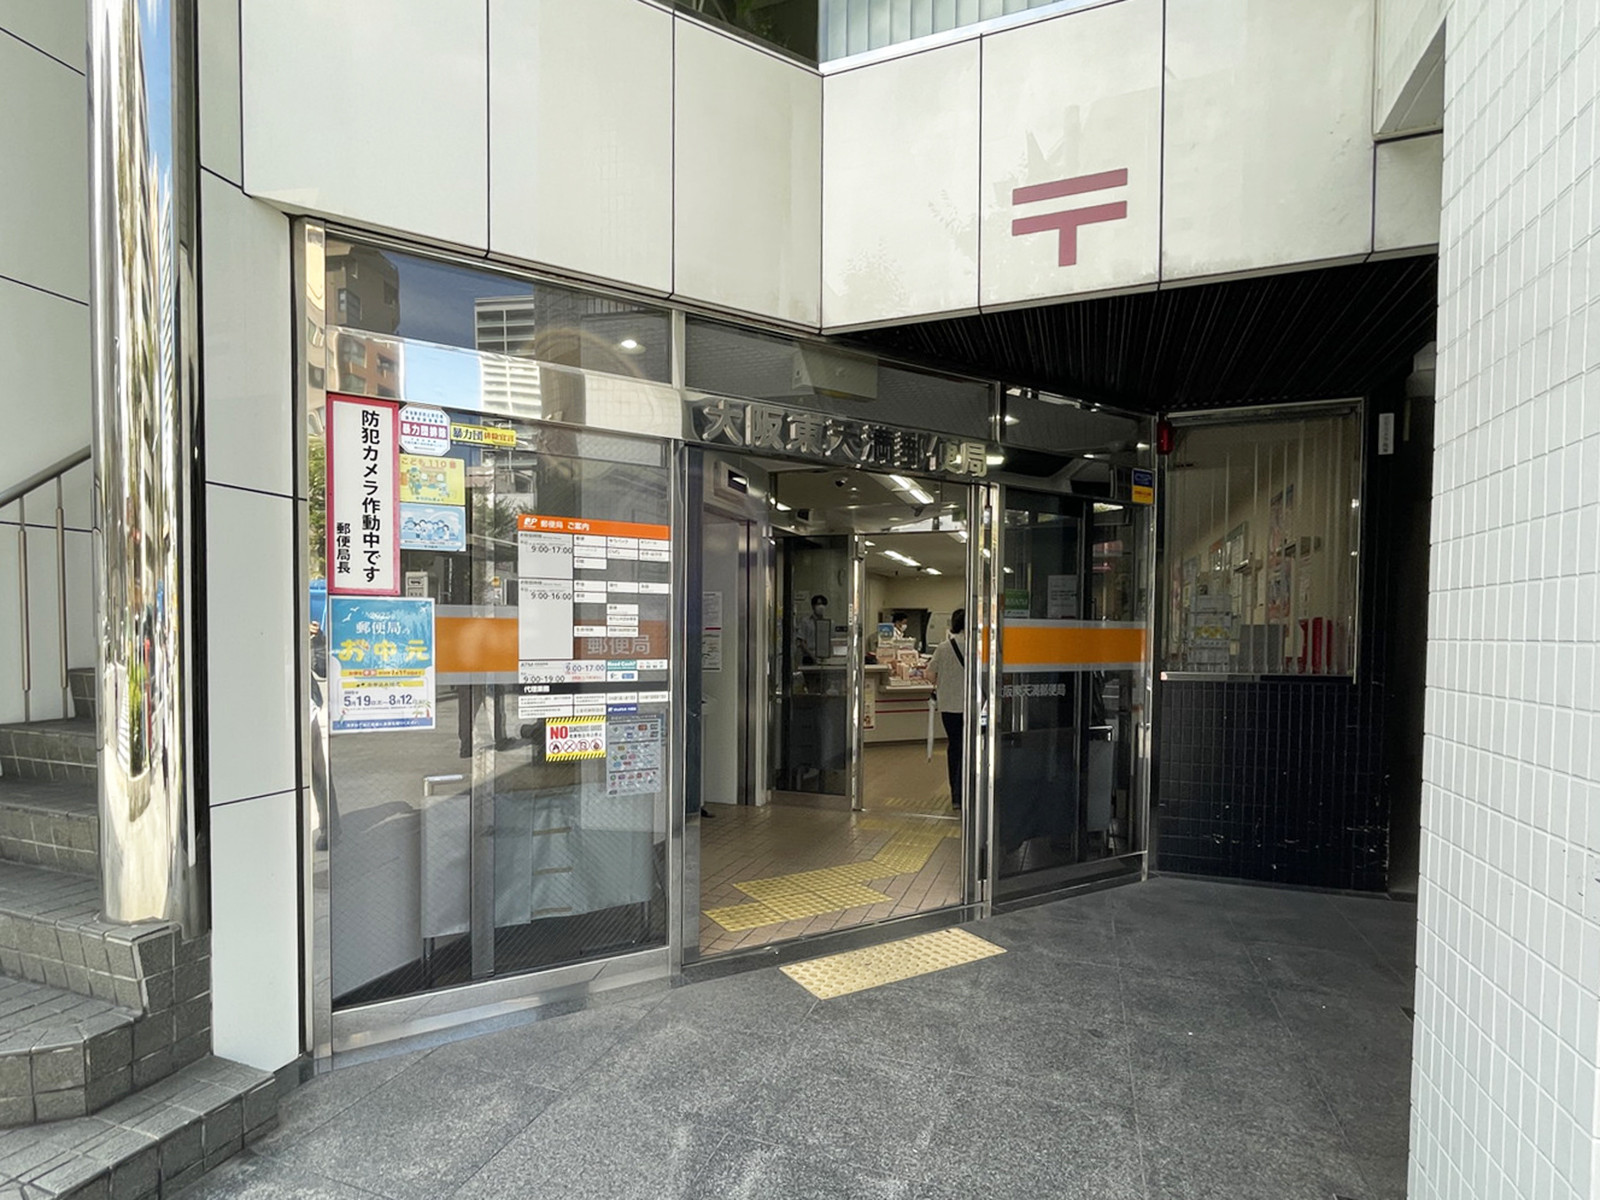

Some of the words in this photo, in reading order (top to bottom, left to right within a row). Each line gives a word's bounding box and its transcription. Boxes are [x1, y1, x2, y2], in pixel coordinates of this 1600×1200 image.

[361, 409, 381, 583] 防犯カメラ作動中です
[336, 522, 351, 574] 郵便局長
[338, 638, 429, 663] お中元
[587, 635, 650, 655] 郵便局
[550, 725, 568, 740] NO
